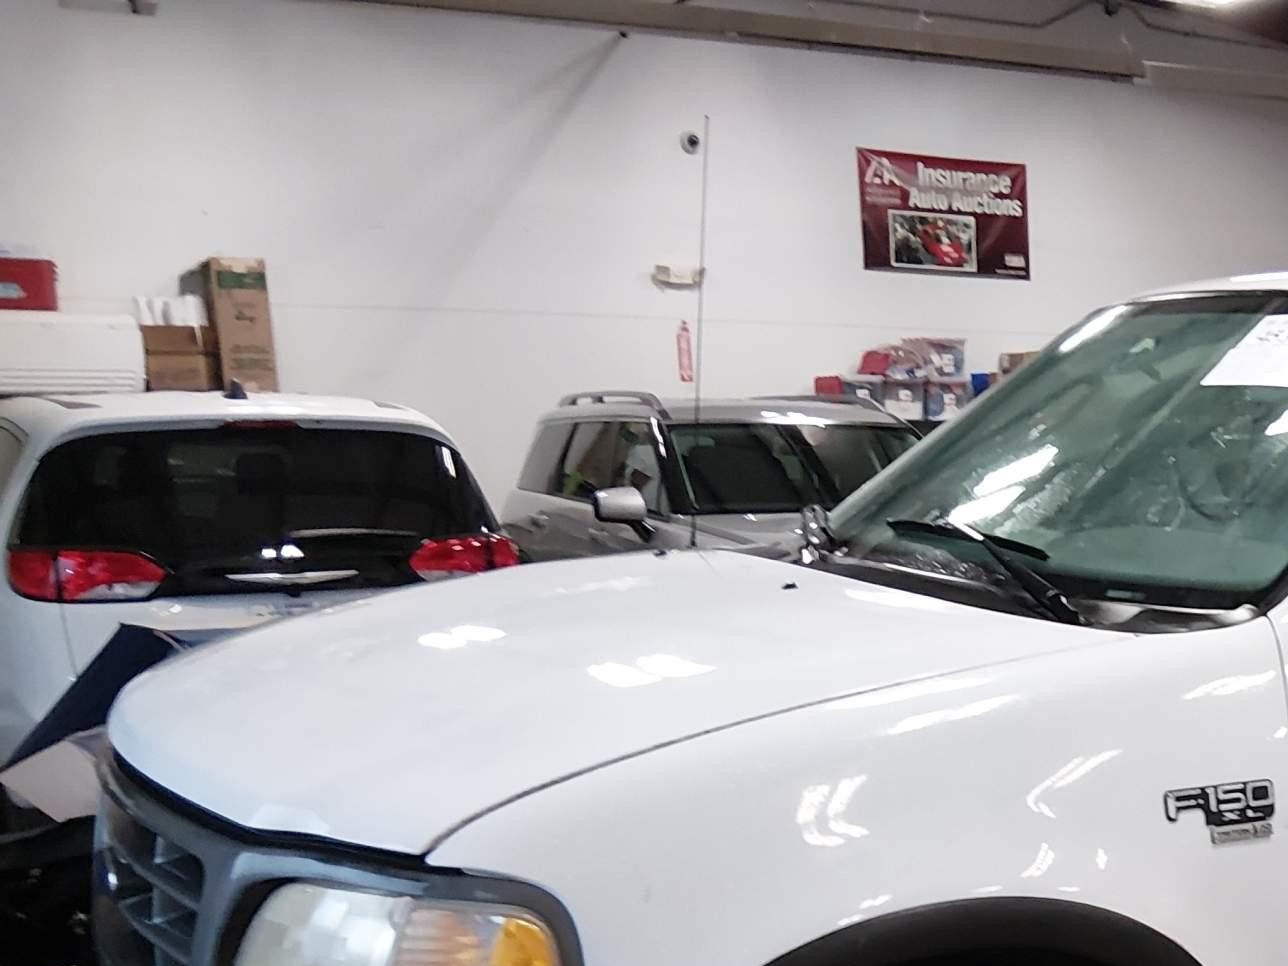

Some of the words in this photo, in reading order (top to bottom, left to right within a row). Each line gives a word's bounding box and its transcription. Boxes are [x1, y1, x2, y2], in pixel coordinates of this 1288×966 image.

[916, 161, 1012, 194] Insurance
[909, 187, 949, 211] Auto
[952, 189, 1023, 217] Auctions
